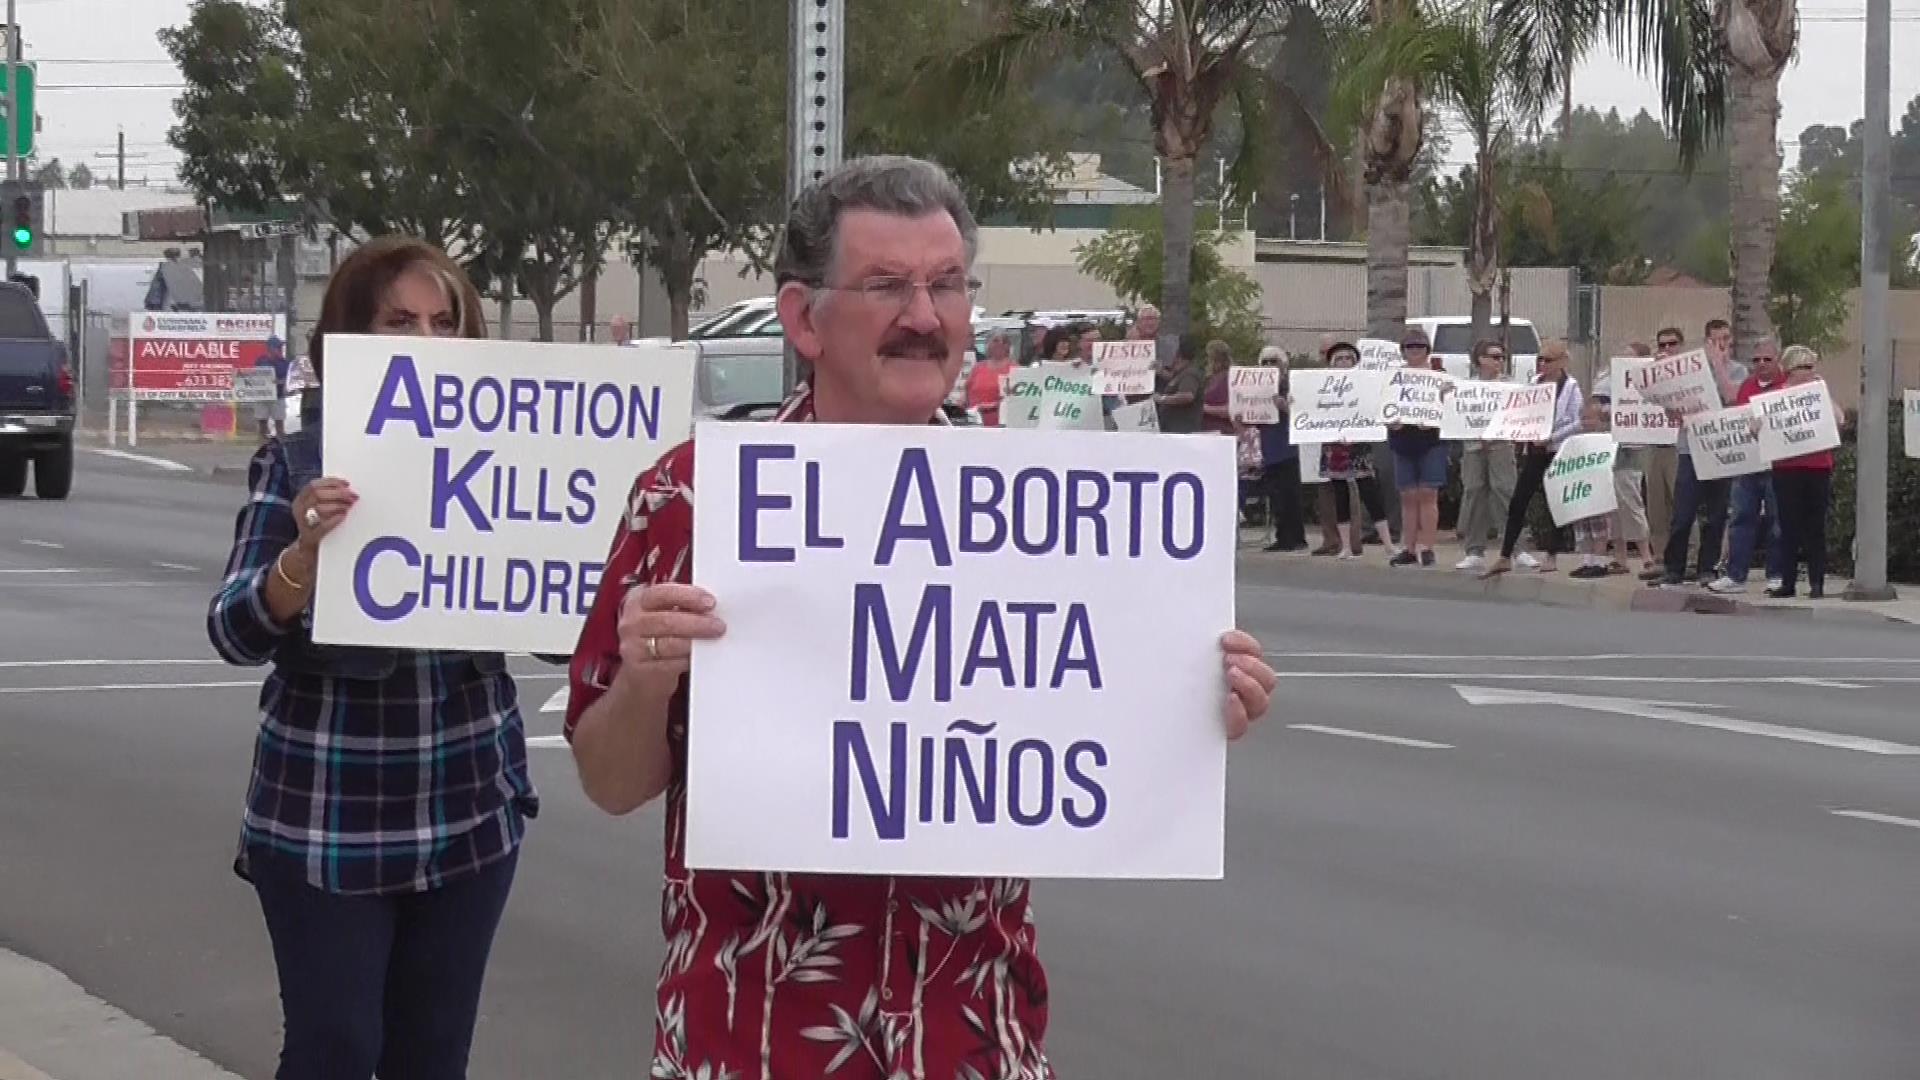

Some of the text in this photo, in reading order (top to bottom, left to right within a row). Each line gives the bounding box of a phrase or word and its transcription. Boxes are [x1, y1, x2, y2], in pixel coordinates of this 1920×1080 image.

[141, 341, 240, 359] AVAILABLE
[1098, 343, 1153, 362] JESUS
[1231, 369, 1277, 387] JESUS
[1389, 371, 1444, 389] ABORTIO
[1639, 355, 1702, 388] JESUS
[365, 354, 661, 440] ABORTION
[1317, 375, 1354, 398] Life
[1399, 387, 1436, 402] KILLS
[1501, 384, 1554, 411] JESUS
[1053, 401, 1081, 419] Life
[1383, 403, 1444, 421] CHILDREN
[1614, 411, 1638, 427] Call
[430, 447, 597, 532] KILLS
[1562, 480, 1593, 504] Life
[737, 444, 1205, 567] EL ABORTO
[353, 535, 605, 621] CHILDRE
[850, 583, 1102, 703] MATA
[832, 719, 1108, 840] NIÑOS
